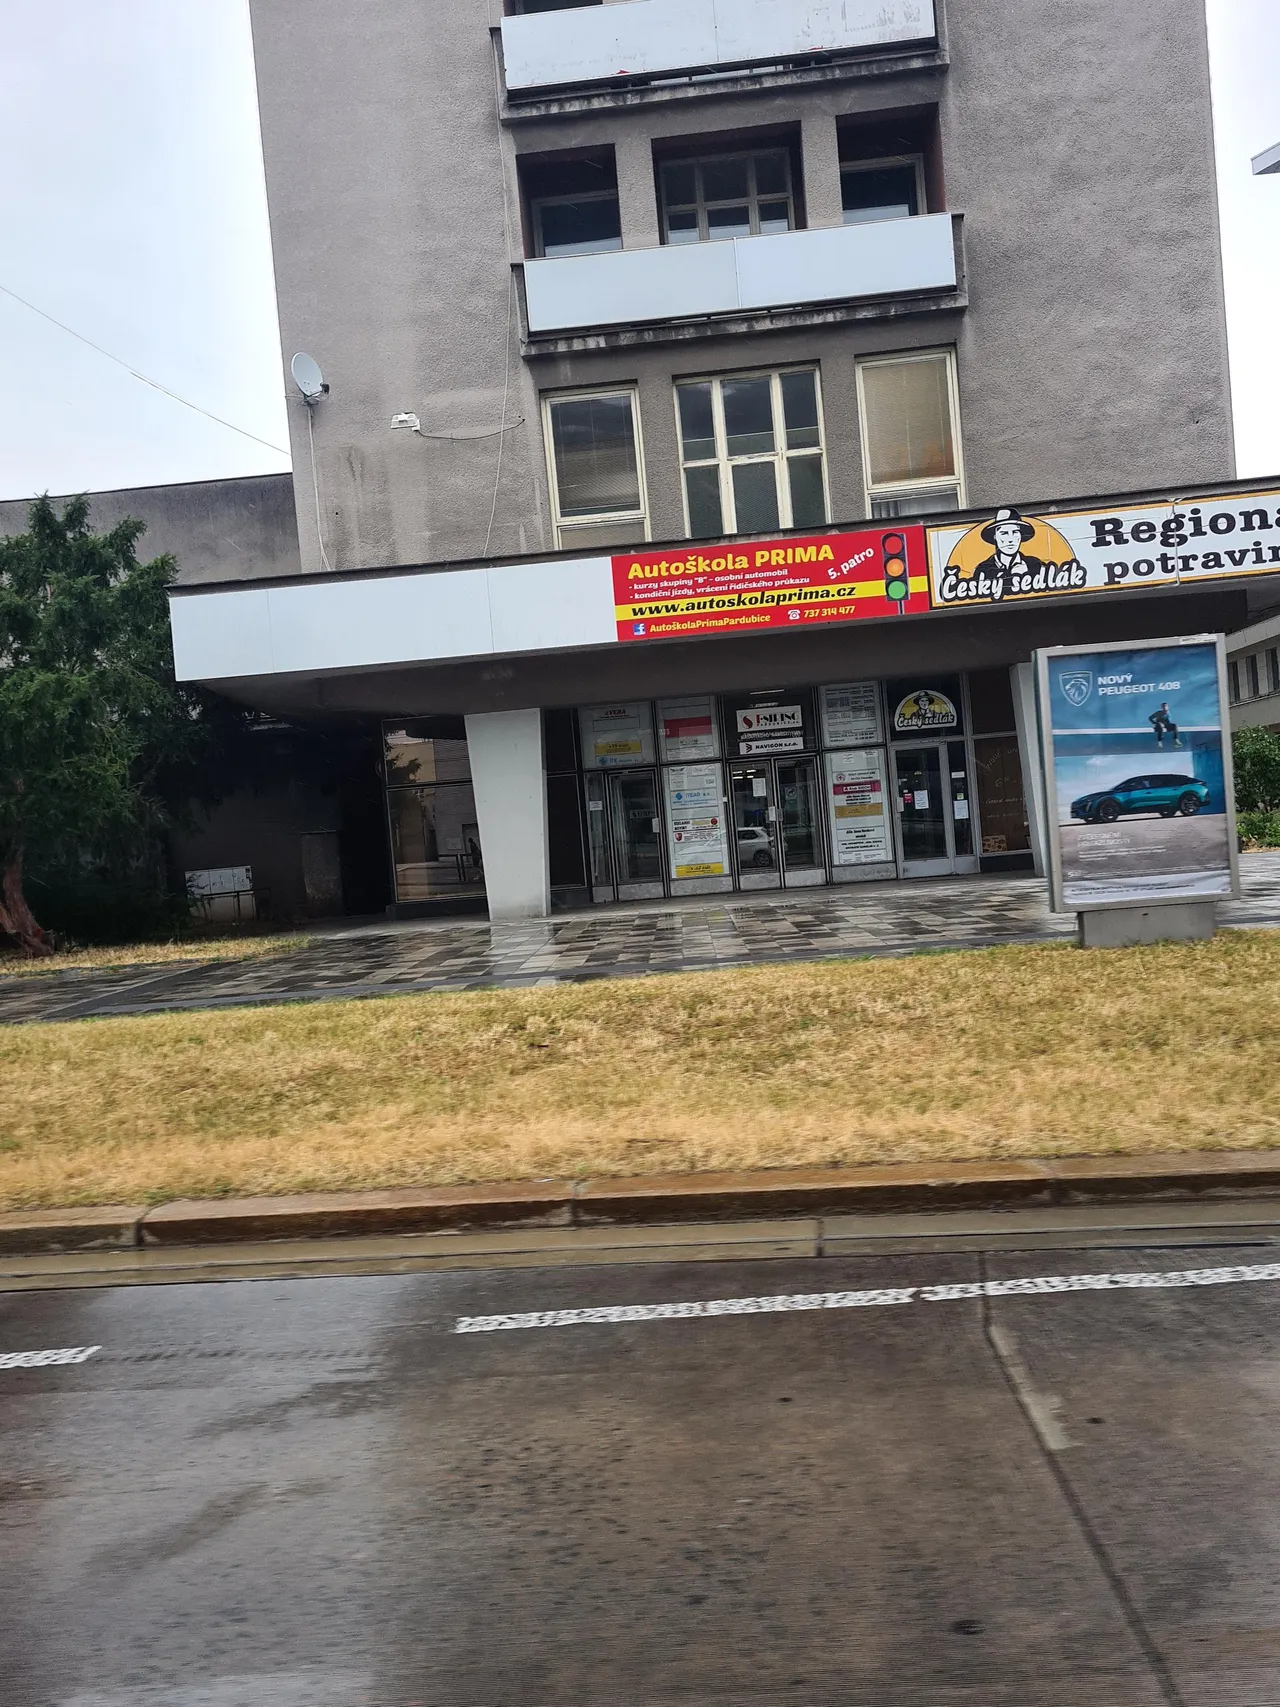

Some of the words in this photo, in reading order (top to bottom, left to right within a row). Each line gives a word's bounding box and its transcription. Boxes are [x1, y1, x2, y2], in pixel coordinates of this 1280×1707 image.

[1090, 507, 1280, 547] Region
[628, 553, 749, 580] Autoškola
[755, 544, 834, 567] PRIMA
[827, 567, 841, 579] 5.
[840, 547, 874, 574] patro
[633, 582, 658, 591] kurzy
[660, 578, 693, 588] skupiny
[714, 572, 743, 582] osobní
[744, 568, 788, 579] automobil
[943, 569, 1003, 600] Český
[1011, 562, 1084, 593] sedlák
[634, 590, 671, 599] kondiční
[696, 584, 728, 593] vrácení
[631, 586, 856, 617] www.autoskolaprima.cz
[803, 608, 820, 618] 737
[821, 607, 837, 616] 314
[838, 605, 855, 615] 477
[649, 614, 771, 633] AutoškolaPrimaPardubice
[1097, 672, 1134, 685] NOVÝ
[1098, 683, 1156, 696] PEUGEOT
[1157, 681, 1181, 691] 408
[898, 713, 923, 728] Český
[924, 712, 954, 725] sedlák
[755, 742, 784, 750] NAVICON
